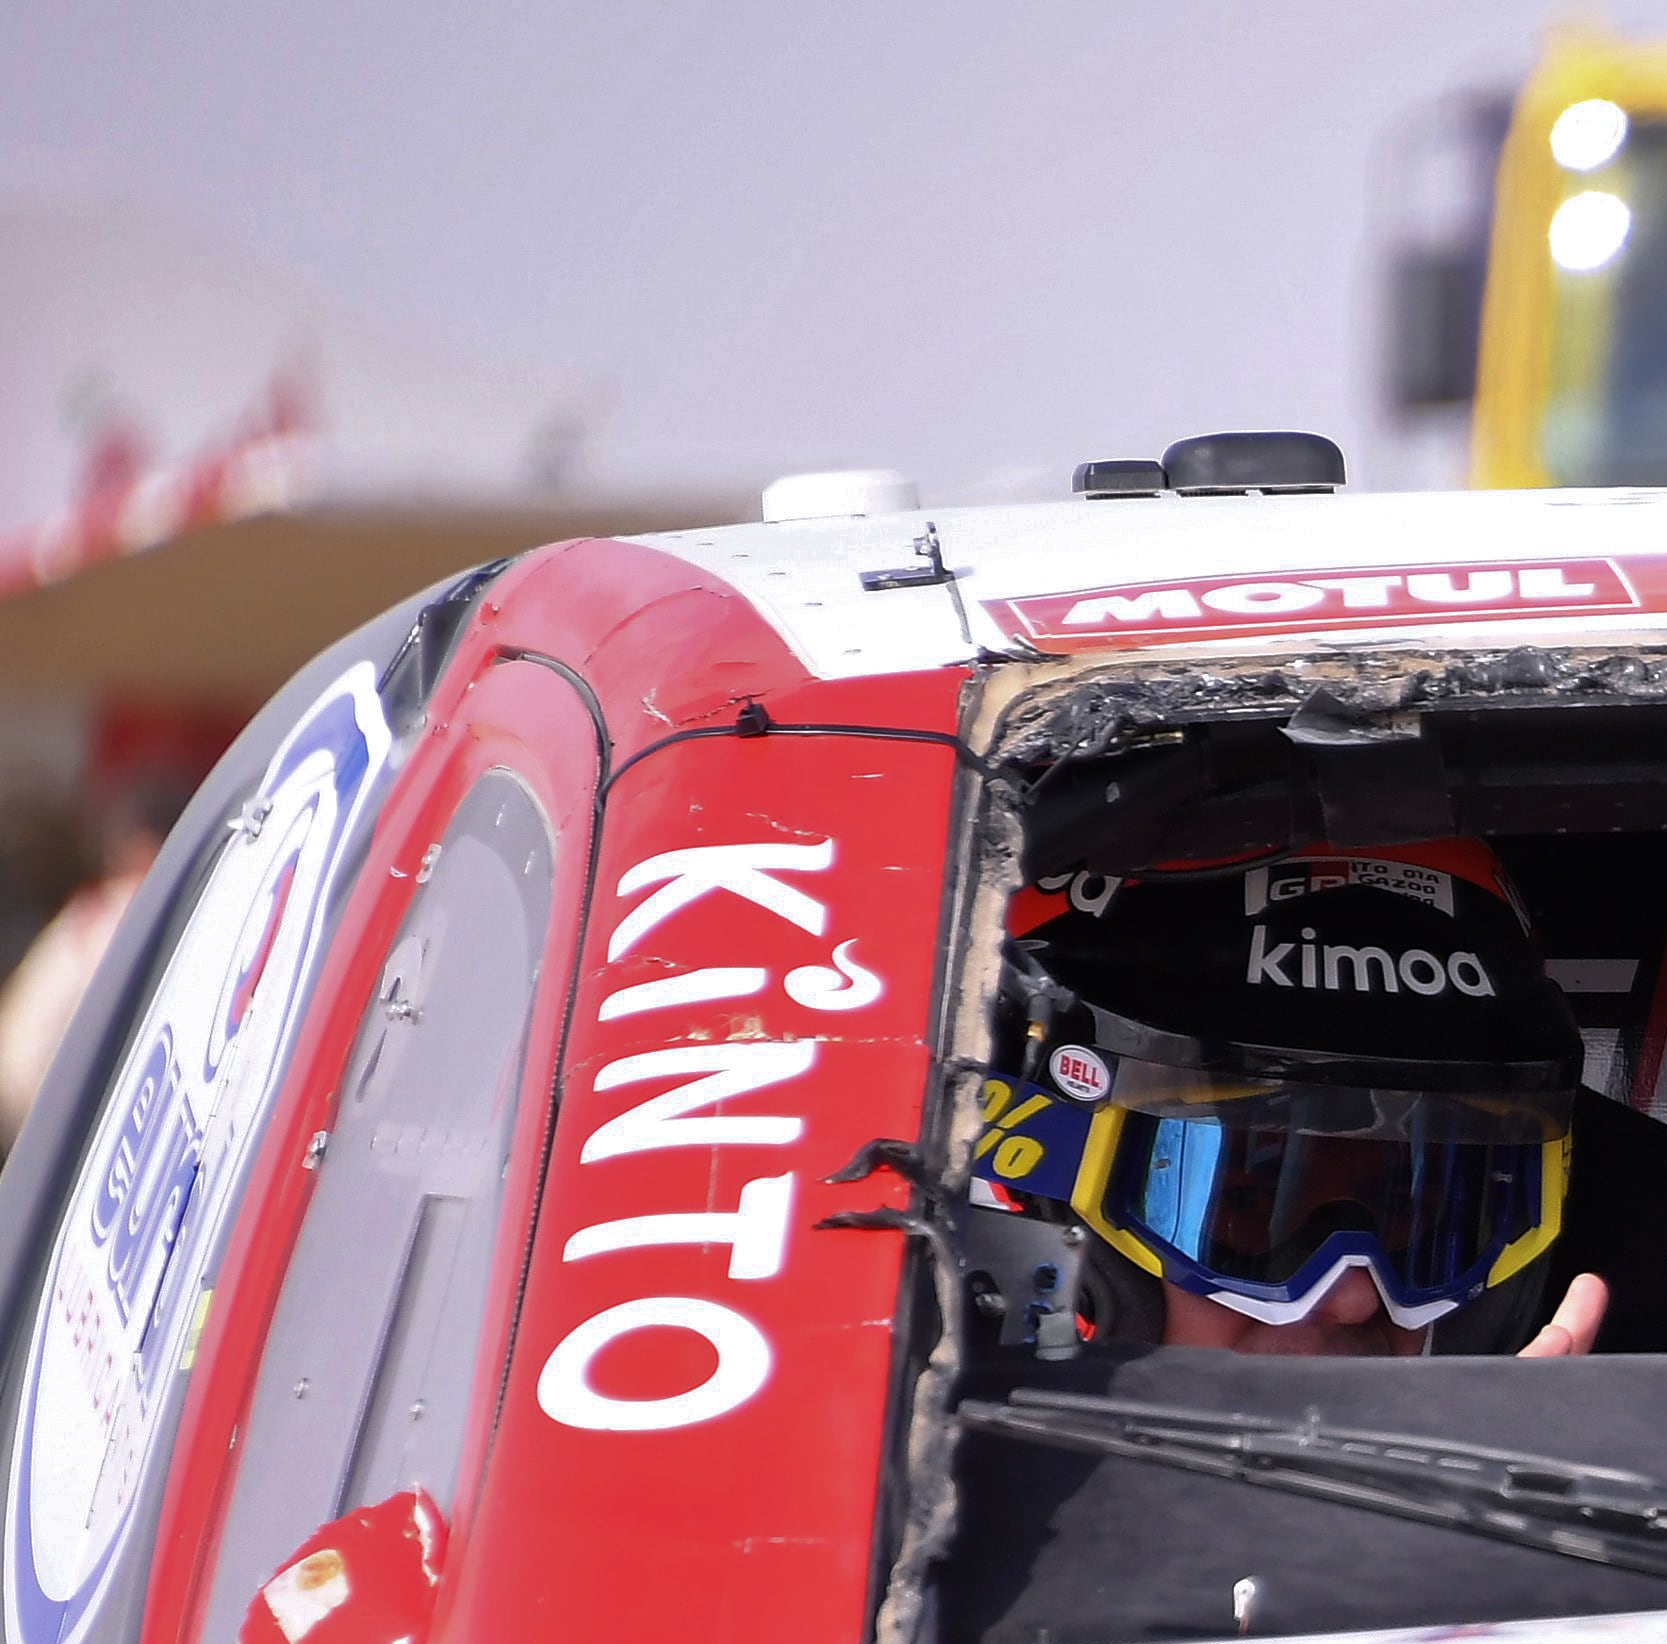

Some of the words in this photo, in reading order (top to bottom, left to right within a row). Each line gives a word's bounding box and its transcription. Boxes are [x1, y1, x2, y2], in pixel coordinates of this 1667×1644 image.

[1062, 567, 1597, 626] MOTUL
[1246, 924, 1497, 997] kimoa
[1059, 1055, 1101, 1089] BELL
